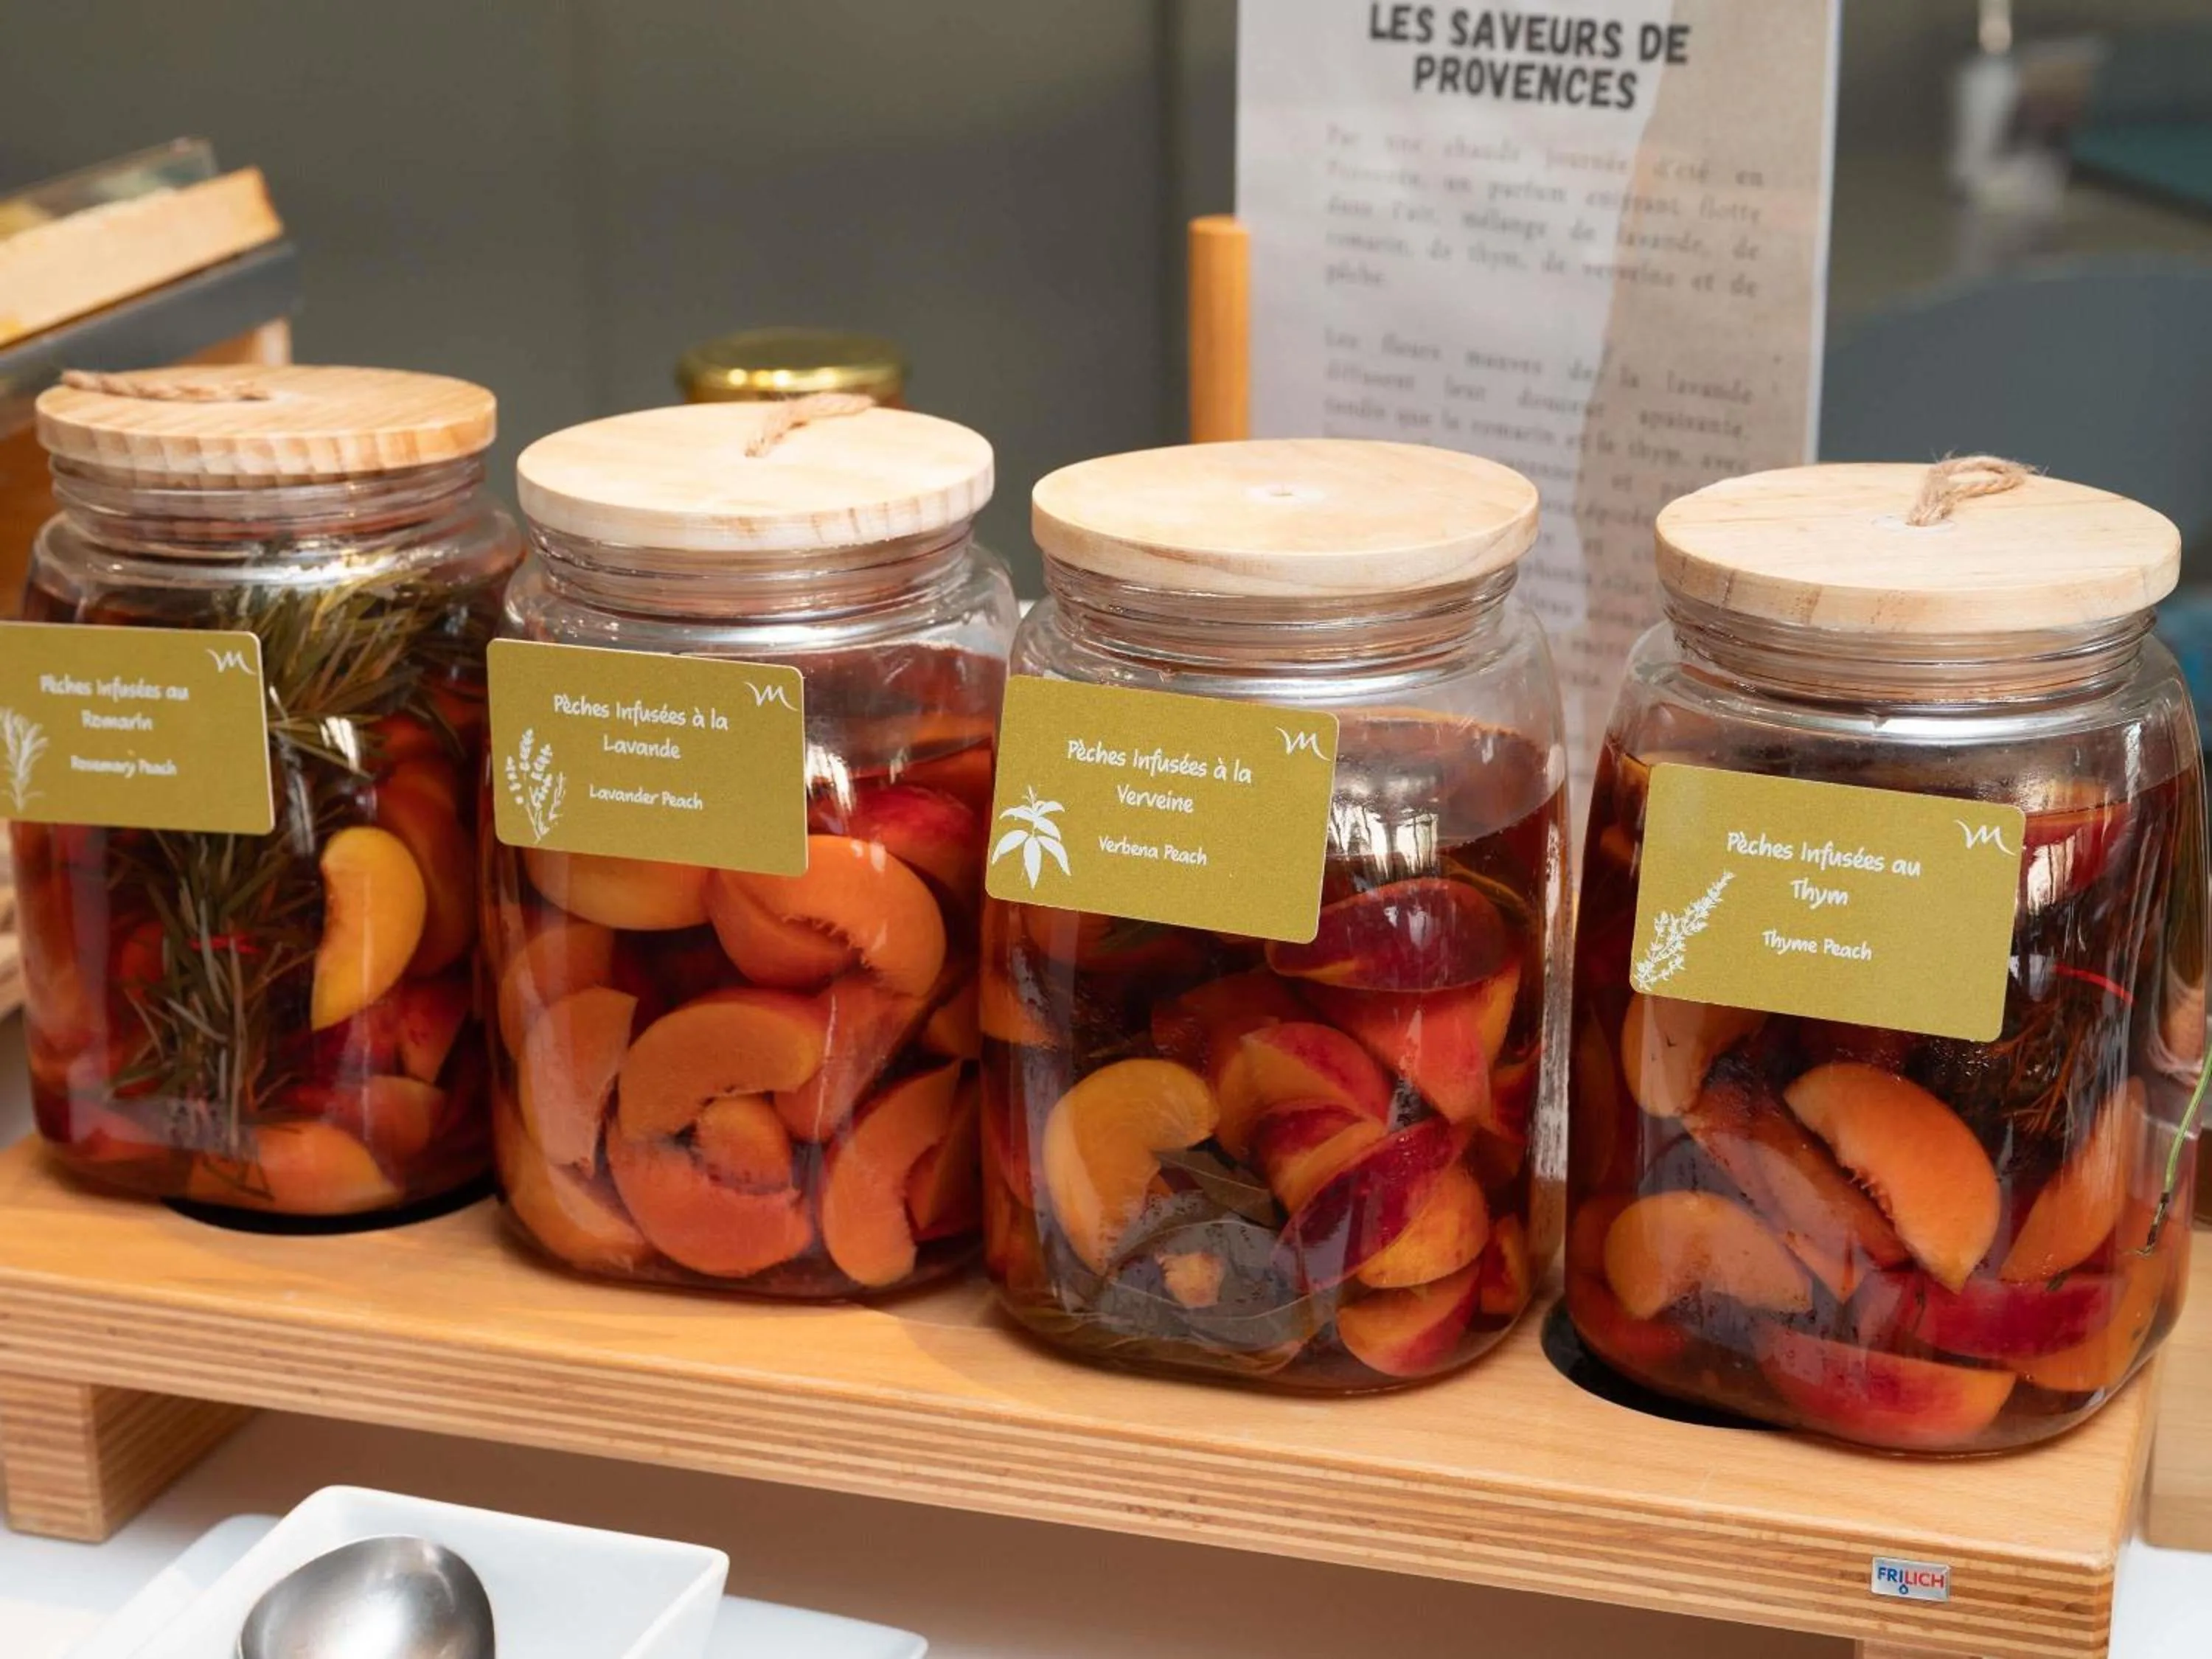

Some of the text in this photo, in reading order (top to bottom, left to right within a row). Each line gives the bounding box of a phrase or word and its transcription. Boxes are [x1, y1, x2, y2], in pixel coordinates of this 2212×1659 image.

[1368, 1, 1691, 65] LES SAVEURS DE
[1413, 53, 1638, 111] PROVENCES
[165, 686, 189, 700] au
[81, 709, 153, 731] Romarin
[616, 700, 686, 727] Infusées
[692, 707, 706, 728] à
[710, 708, 728, 731] la
[603, 734, 681, 759] Lavande
[1132, 748, 1207, 778] Infusées
[1213, 757, 1227, 782] à
[1234, 759, 1253, 784] la
[662, 790, 703, 810] Peach
[1116, 784, 1194, 814] Verveine
[1099, 836, 1208, 866] Verbena Peach
[1800, 841, 1885, 872] Infusées
[1891, 858, 1921, 877] au
[1790, 877, 1849, 910] Thym
[1761, 929, 1873, 962] Thyme Peach
[1877, 1567, 1945, 1588] FRILICH
